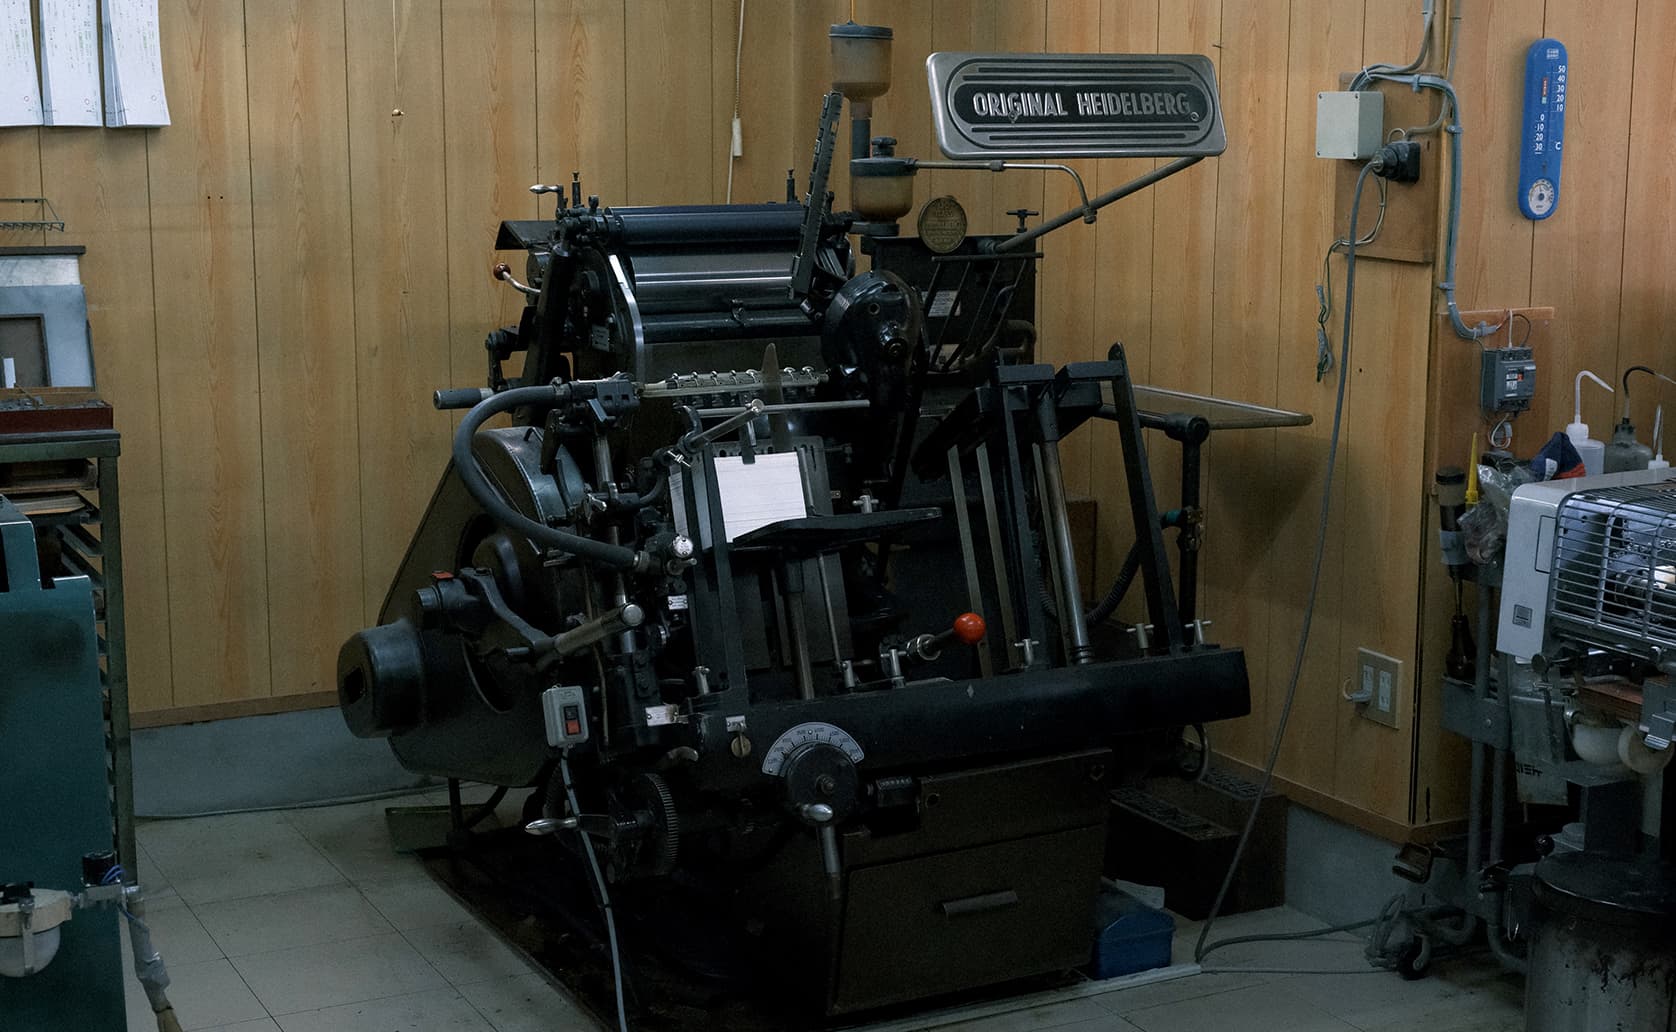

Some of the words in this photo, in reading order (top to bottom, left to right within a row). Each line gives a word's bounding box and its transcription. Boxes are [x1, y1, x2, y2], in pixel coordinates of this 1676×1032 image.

[1558, 65, 1566, 73] 50
[973, 92, 1068, 116] ORIGINAL
[1076, 92, 1191, 116] HEIDELBERG
